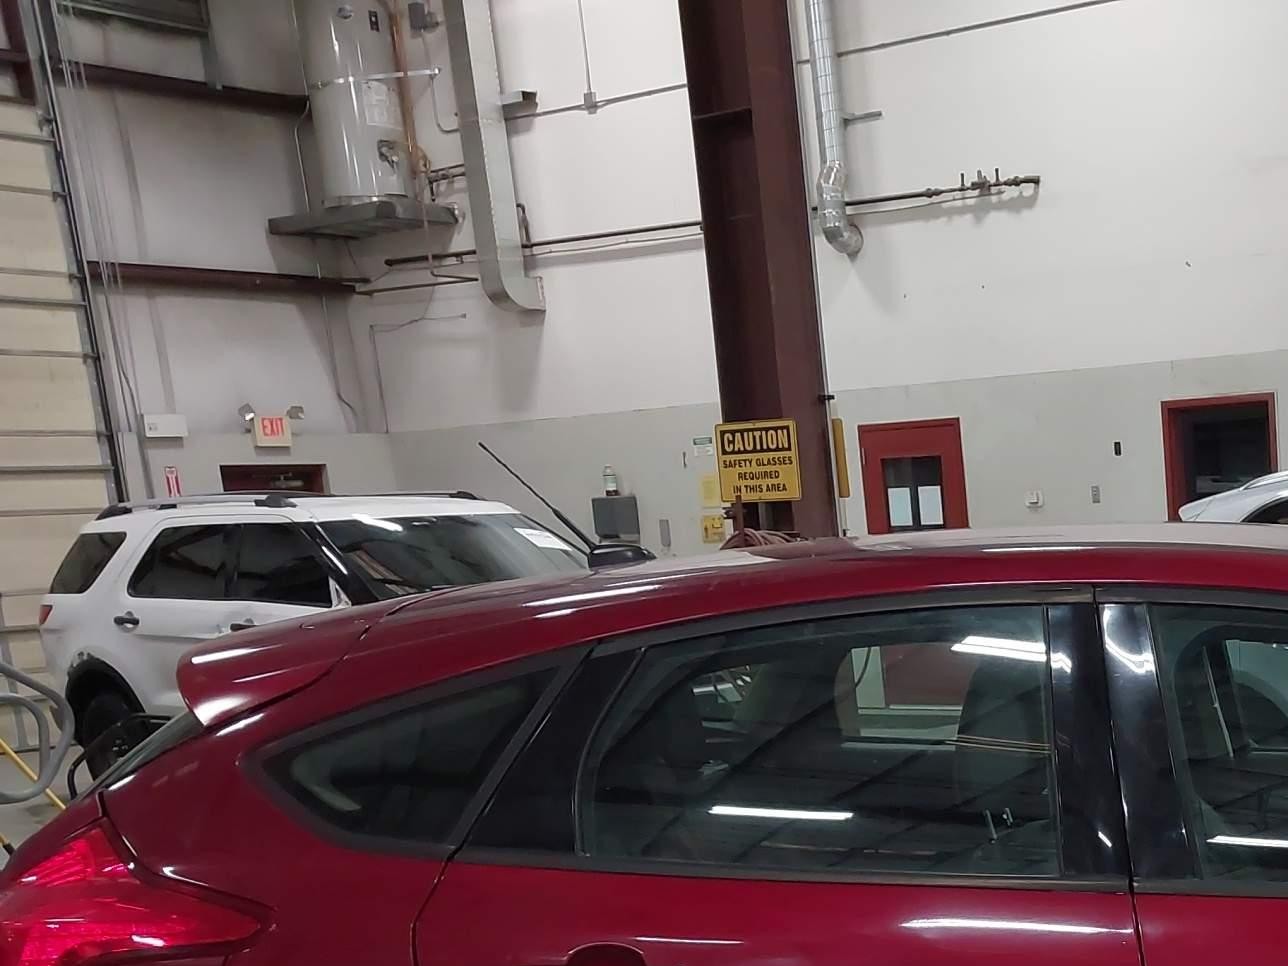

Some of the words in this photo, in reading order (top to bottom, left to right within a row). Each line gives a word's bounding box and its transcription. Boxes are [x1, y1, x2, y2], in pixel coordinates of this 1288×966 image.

[261, 416, 285, 437] EXIT
[723, 429, 789, 452] CAUTION
[722, 458, 753, 469] SAFETY
[755, 456, 793, 467] GLASSES
[737, 470, 780, 481] REQUIRED
[733, 485, 742, 494] IN
[744, 484, 764, 493] THIS
[765, 483, 788, 493] AREA
